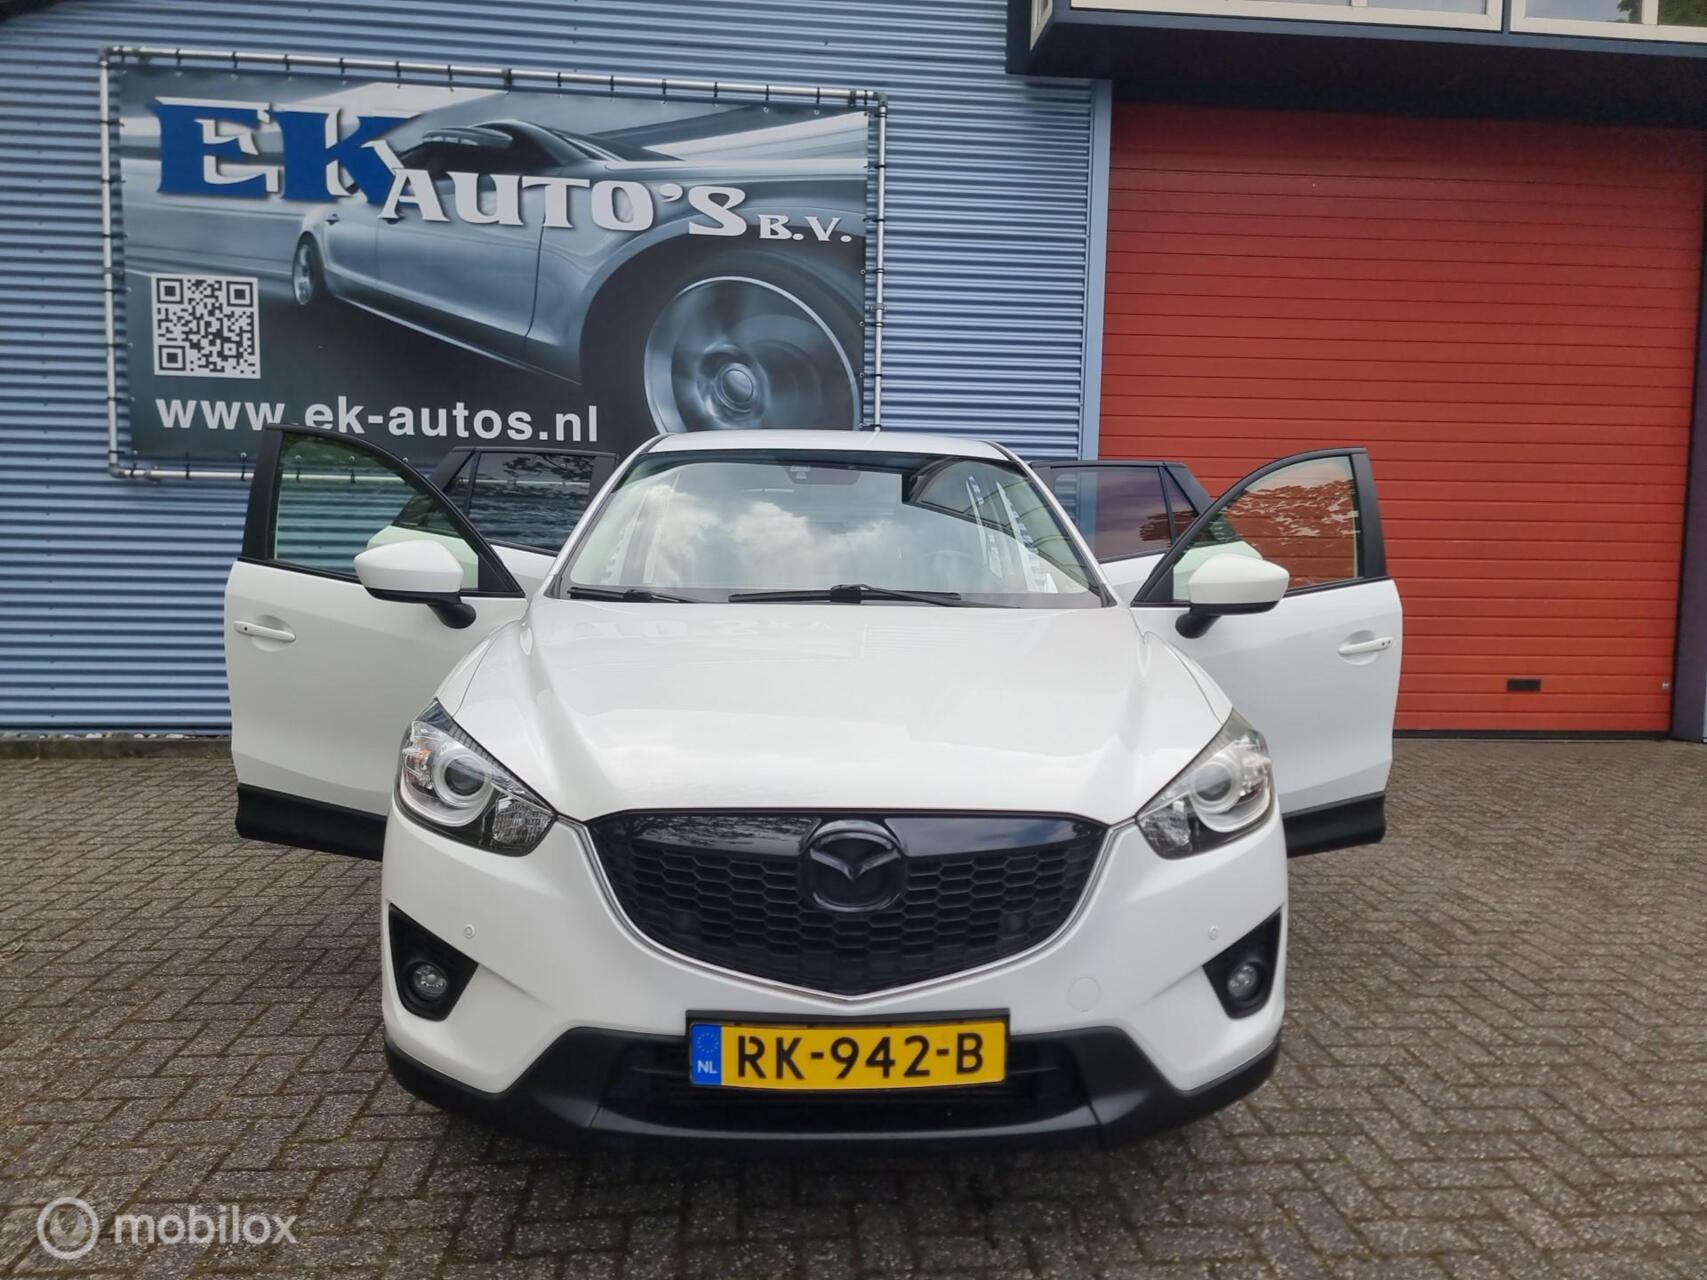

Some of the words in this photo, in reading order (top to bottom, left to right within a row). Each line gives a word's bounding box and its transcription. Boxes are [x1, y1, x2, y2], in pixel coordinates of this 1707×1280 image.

[155, 96, 424, 207] EK
[758, 214, 852, 243] B.V.
[155, 396, 599, 443] wwwek-autos.nl
[697, 1060, 718, 1075] NL
[737, 1033, 984, 1080] RK-942-B
